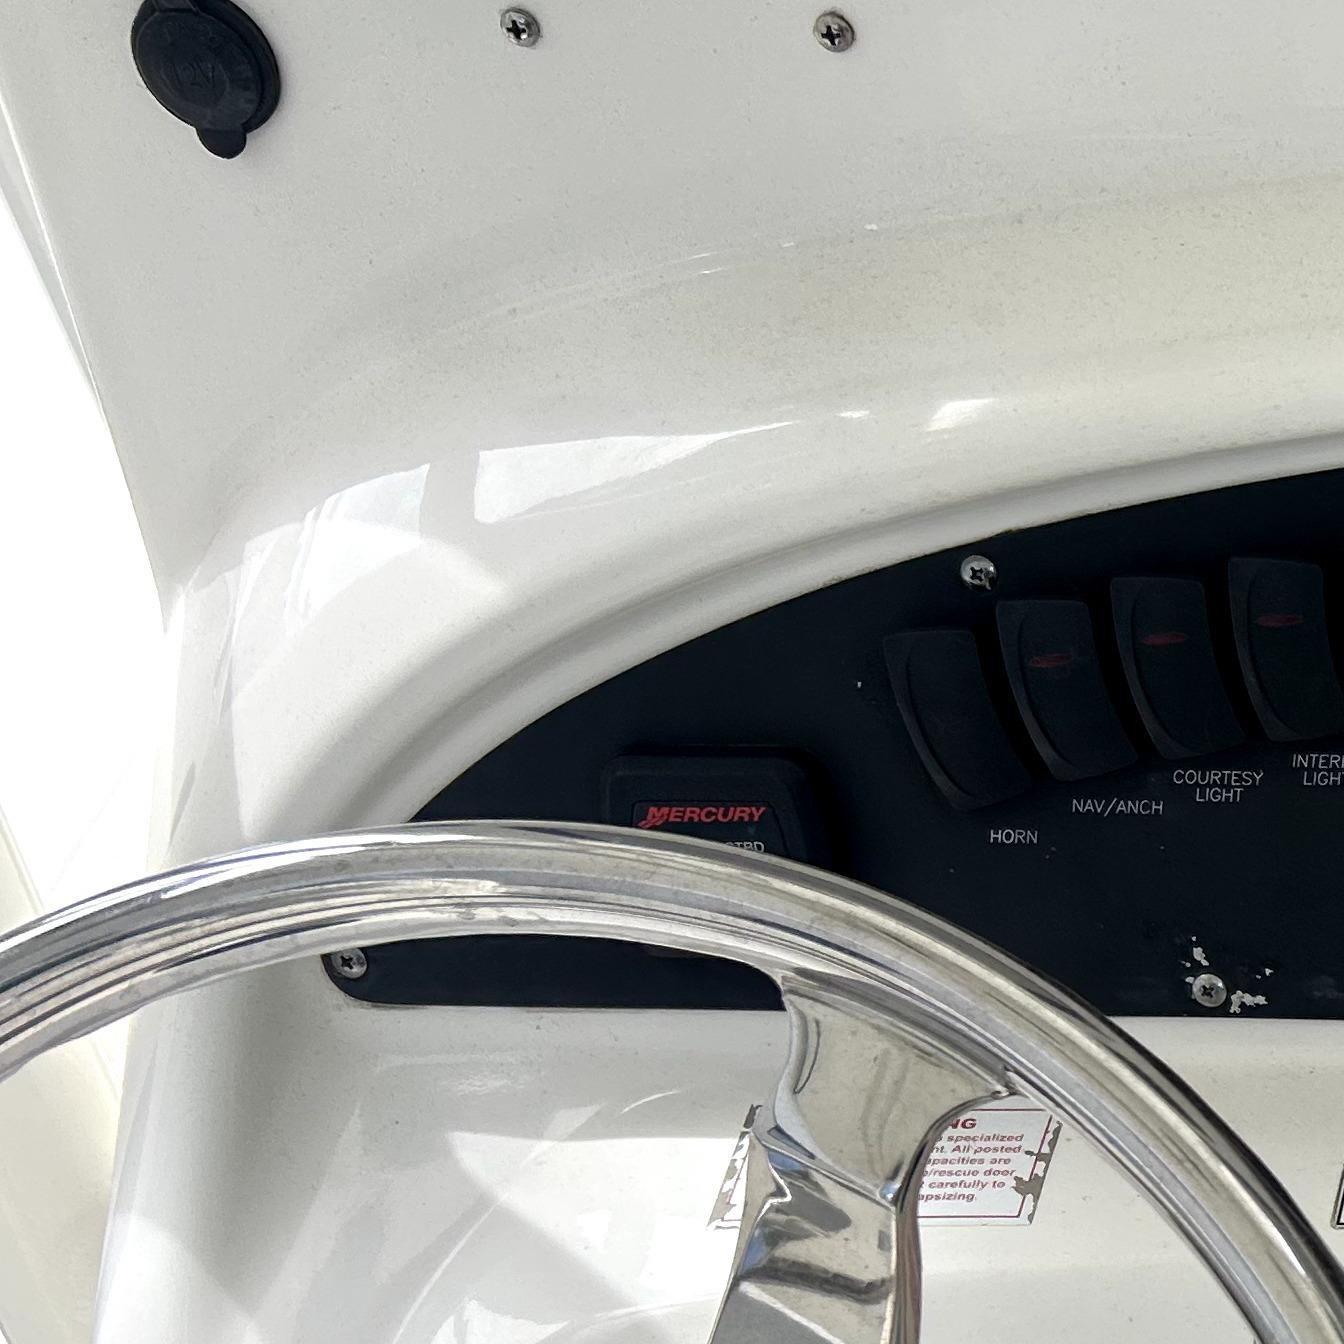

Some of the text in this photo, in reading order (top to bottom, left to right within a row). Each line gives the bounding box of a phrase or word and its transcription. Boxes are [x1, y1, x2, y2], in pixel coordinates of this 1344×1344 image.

[1173, 769, 1263, 788] COURTESY
[1196, 787, 1243, 802] LIGHT
[1072, 798, 1162, 816] NAV/ANCH
[638, 807, 767, 828] MERCURY
[990, 829, 1037, 843] HORN
[947, 1133, 1024, 1145] specialized
